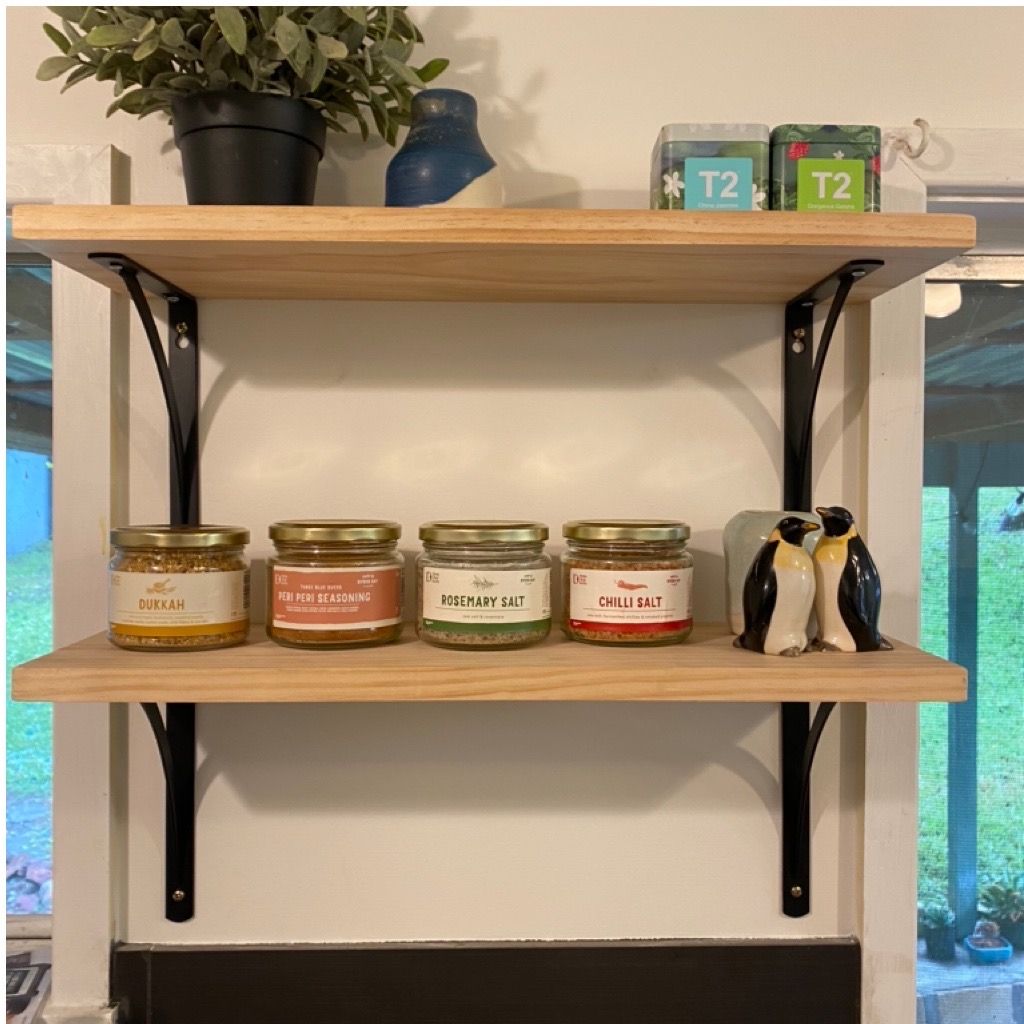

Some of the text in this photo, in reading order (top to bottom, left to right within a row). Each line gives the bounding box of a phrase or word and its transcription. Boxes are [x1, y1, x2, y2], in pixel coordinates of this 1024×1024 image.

[698, 171, 739, 199] T2
[811, 171, 852, 199] T2
[278, 591, 371, 604] PERI PERI SEASONING
[441, 594, 526, 608] ROSEMARY SALT
[598, 595, 663, 608] CHILLI SALT
[138, 598, 186, 611] DUKKAH
